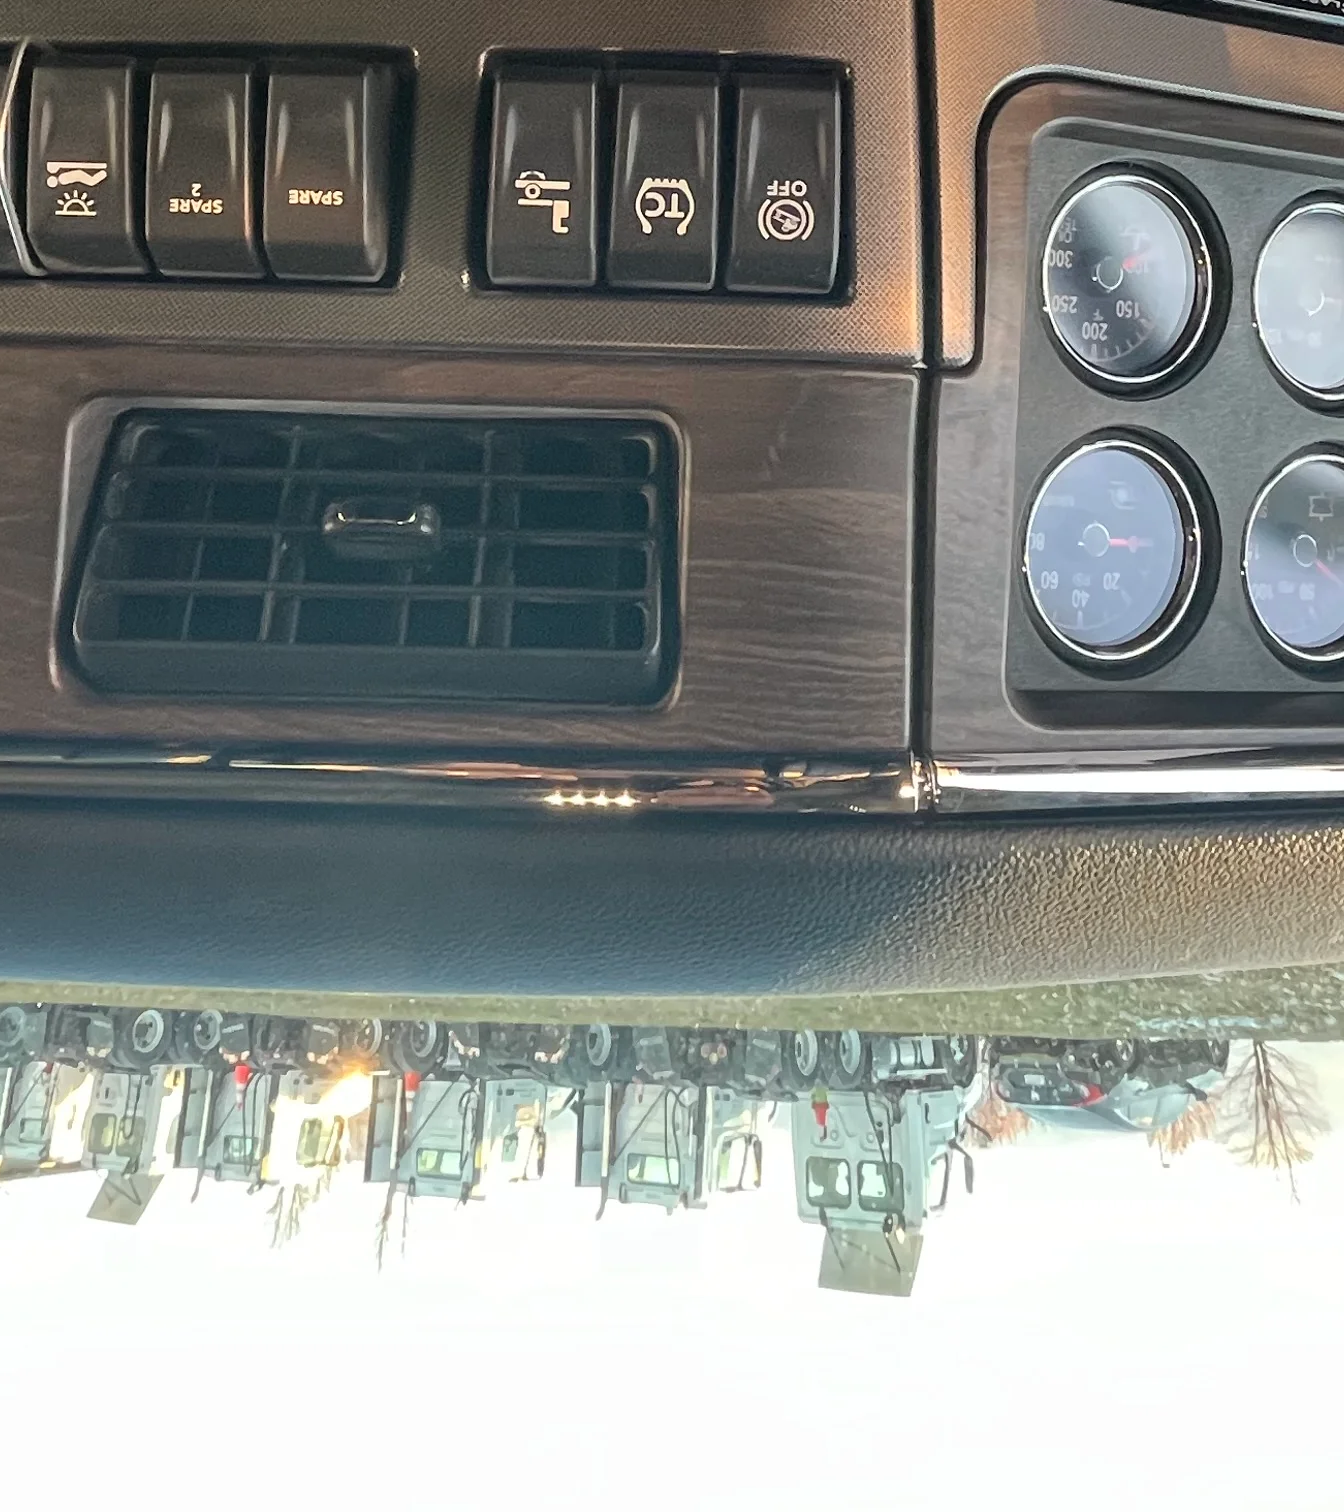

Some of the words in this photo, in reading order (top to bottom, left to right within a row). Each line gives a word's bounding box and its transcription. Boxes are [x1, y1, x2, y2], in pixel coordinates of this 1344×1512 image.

[190, 182, 202, 197] 2
[288, 188, 344, 206] SPARE
[766, 179, 808, 196] OFF
[168, 196, 224, 215] SPARE
[644, 191, 685, 219] TC
[1051, 294, 1078, 314] 250
[1115, 299, 1141, 318] 150
[1082, 321, 1108, 341] 200
[1040, 570, 1059, 590] 60
[1103, 572, 1121, 591] 20
[1071, 588, 1090, 609] 40
